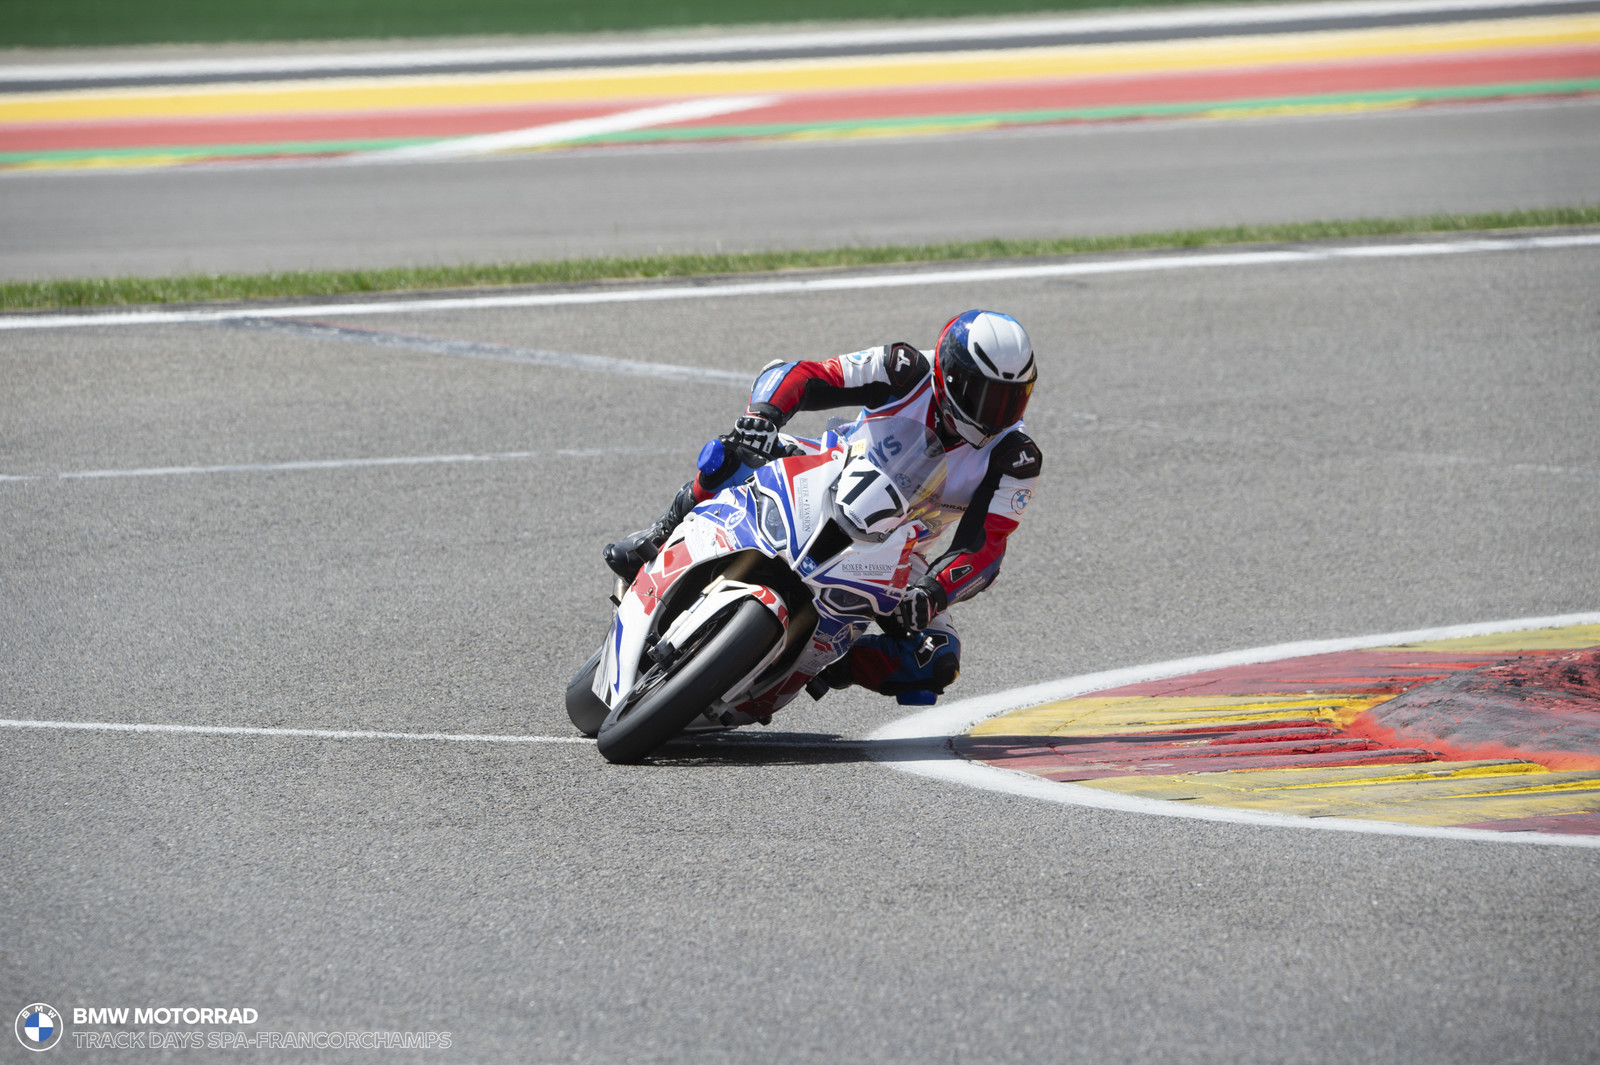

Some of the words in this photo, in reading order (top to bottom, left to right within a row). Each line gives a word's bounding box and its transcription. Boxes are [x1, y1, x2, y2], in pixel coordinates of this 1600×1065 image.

[801, 478, 809, 497] BOXER
[841, 469, 903, 528] 17
[803, 503, 811, 532] EVASION
